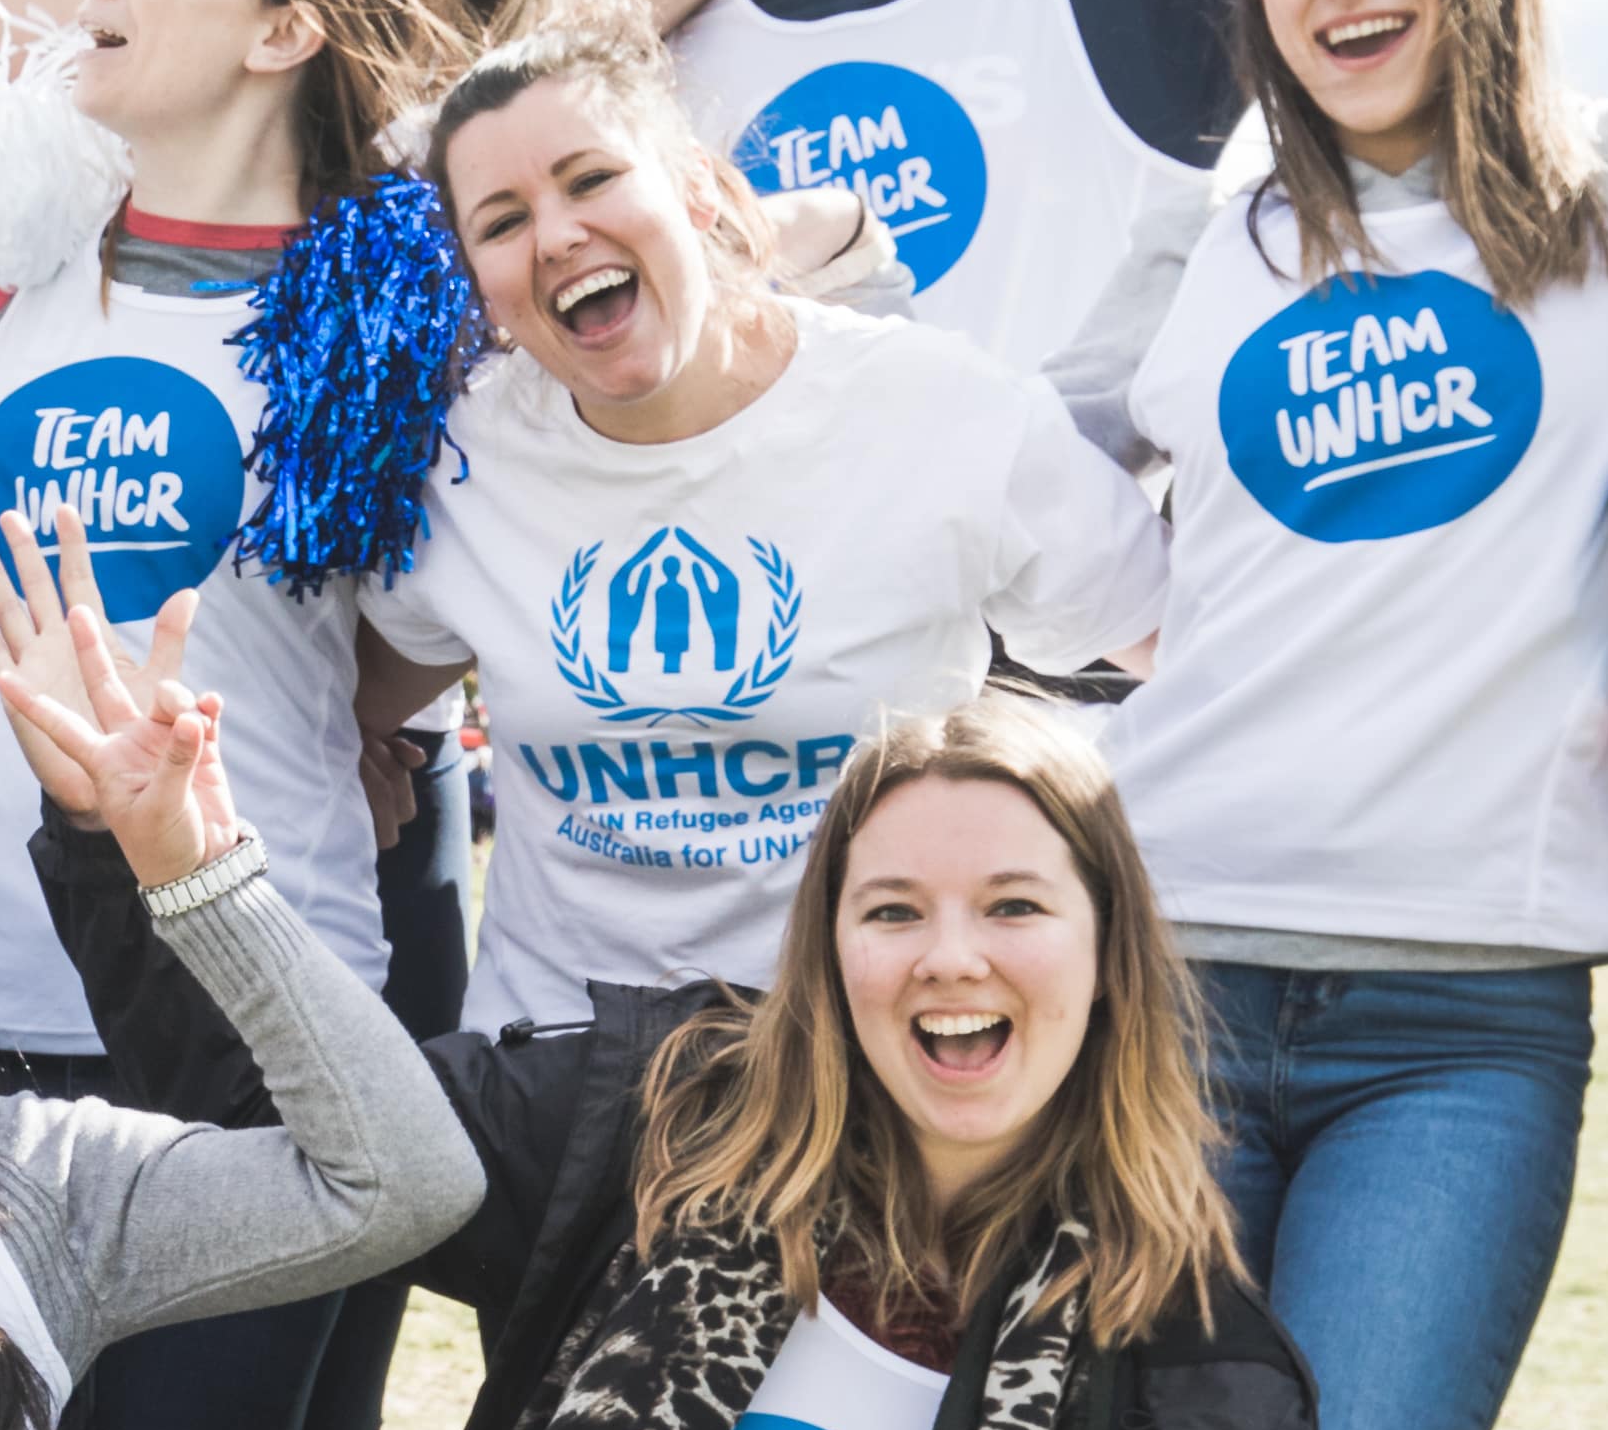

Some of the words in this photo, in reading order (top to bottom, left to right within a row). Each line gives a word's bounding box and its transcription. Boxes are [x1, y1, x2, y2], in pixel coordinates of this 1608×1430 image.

[769, 105, 908, 190] TEAM
[1278, 307, 1449, 396] TEAM
[33, 406, 171, 471] TEAM
[1276, 366, 1493, 468] UNHCR
[15, 466, 191, 533] UNHCR
[519, 733, 856, 804] UNHCR
[557, 814, 673, 868] Australia
[681, 843, 727, 869] for
[635, 811, 749, 833] Refugee
[759, 798, 829, 823] Agen
